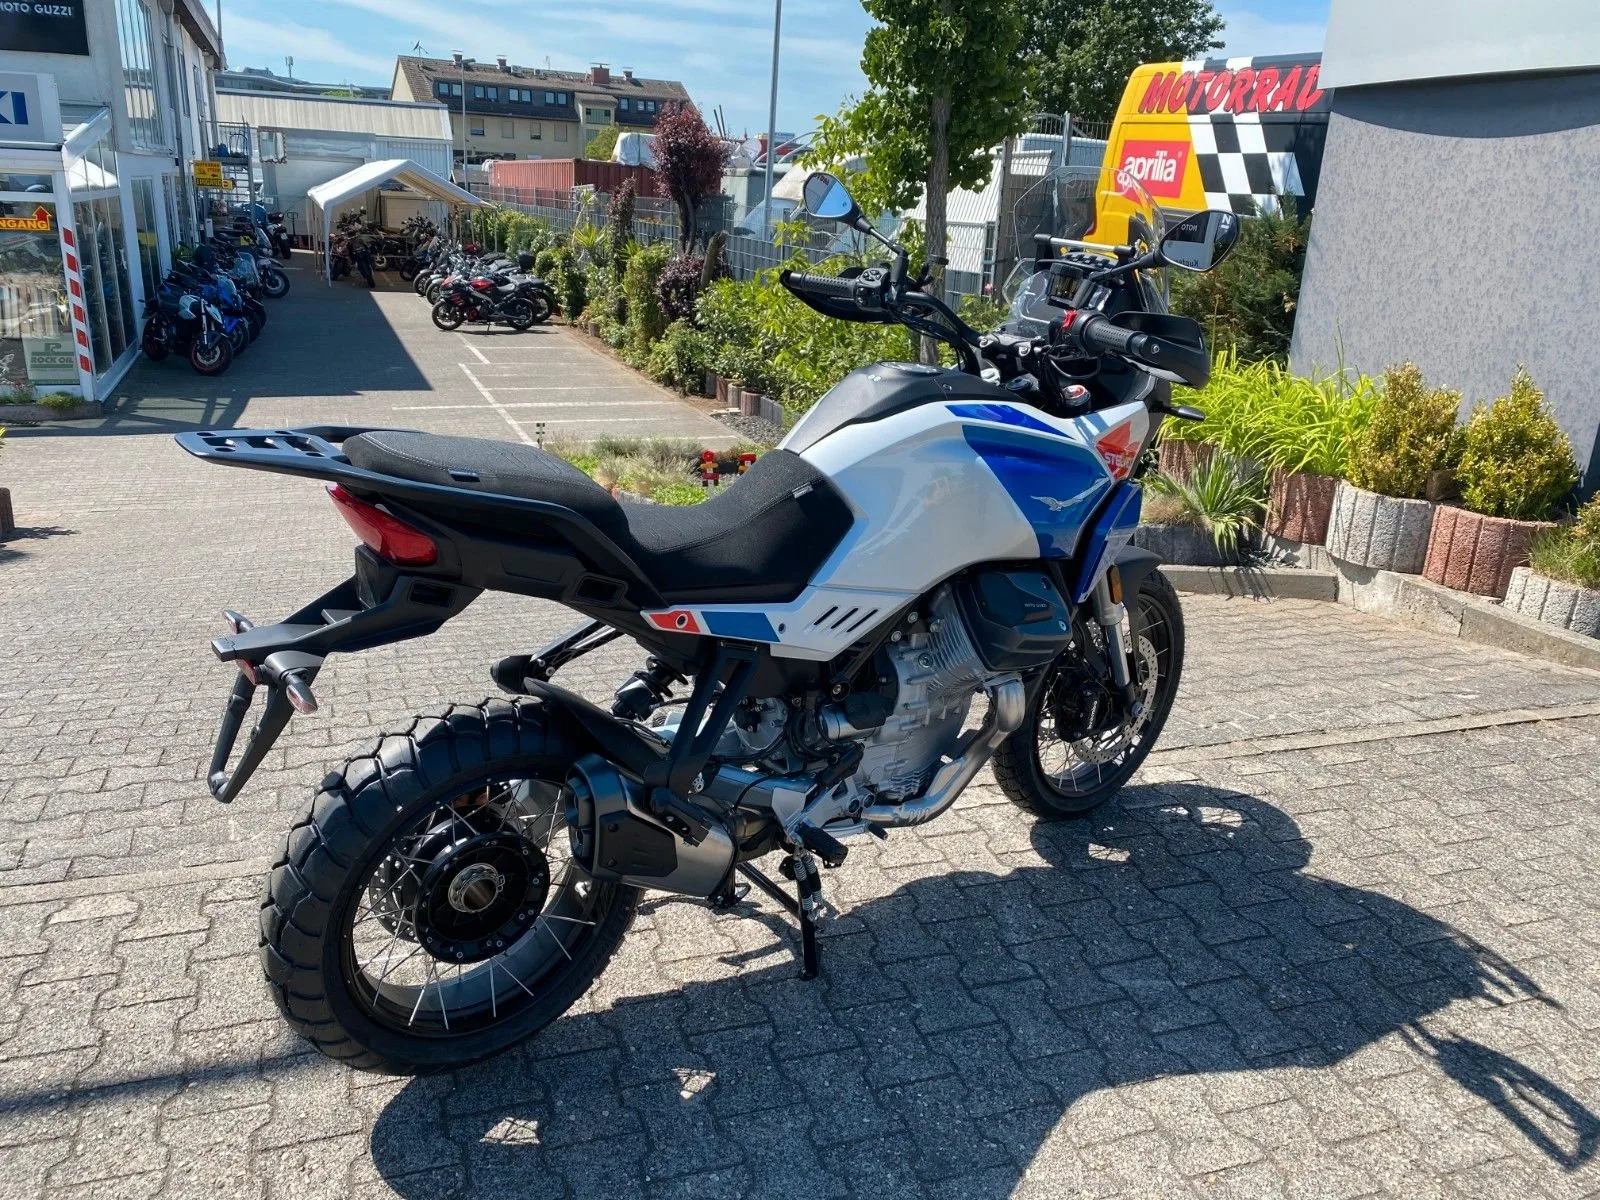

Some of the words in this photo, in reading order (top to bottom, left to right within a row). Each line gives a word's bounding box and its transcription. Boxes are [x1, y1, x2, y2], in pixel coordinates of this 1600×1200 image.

[34, 4, 72, 16] GUZZI
[1122, 150, 1177, 183] aprilia
[31, 356, 56, 364] ROCK
[58, 356, 74, 364] OIL
